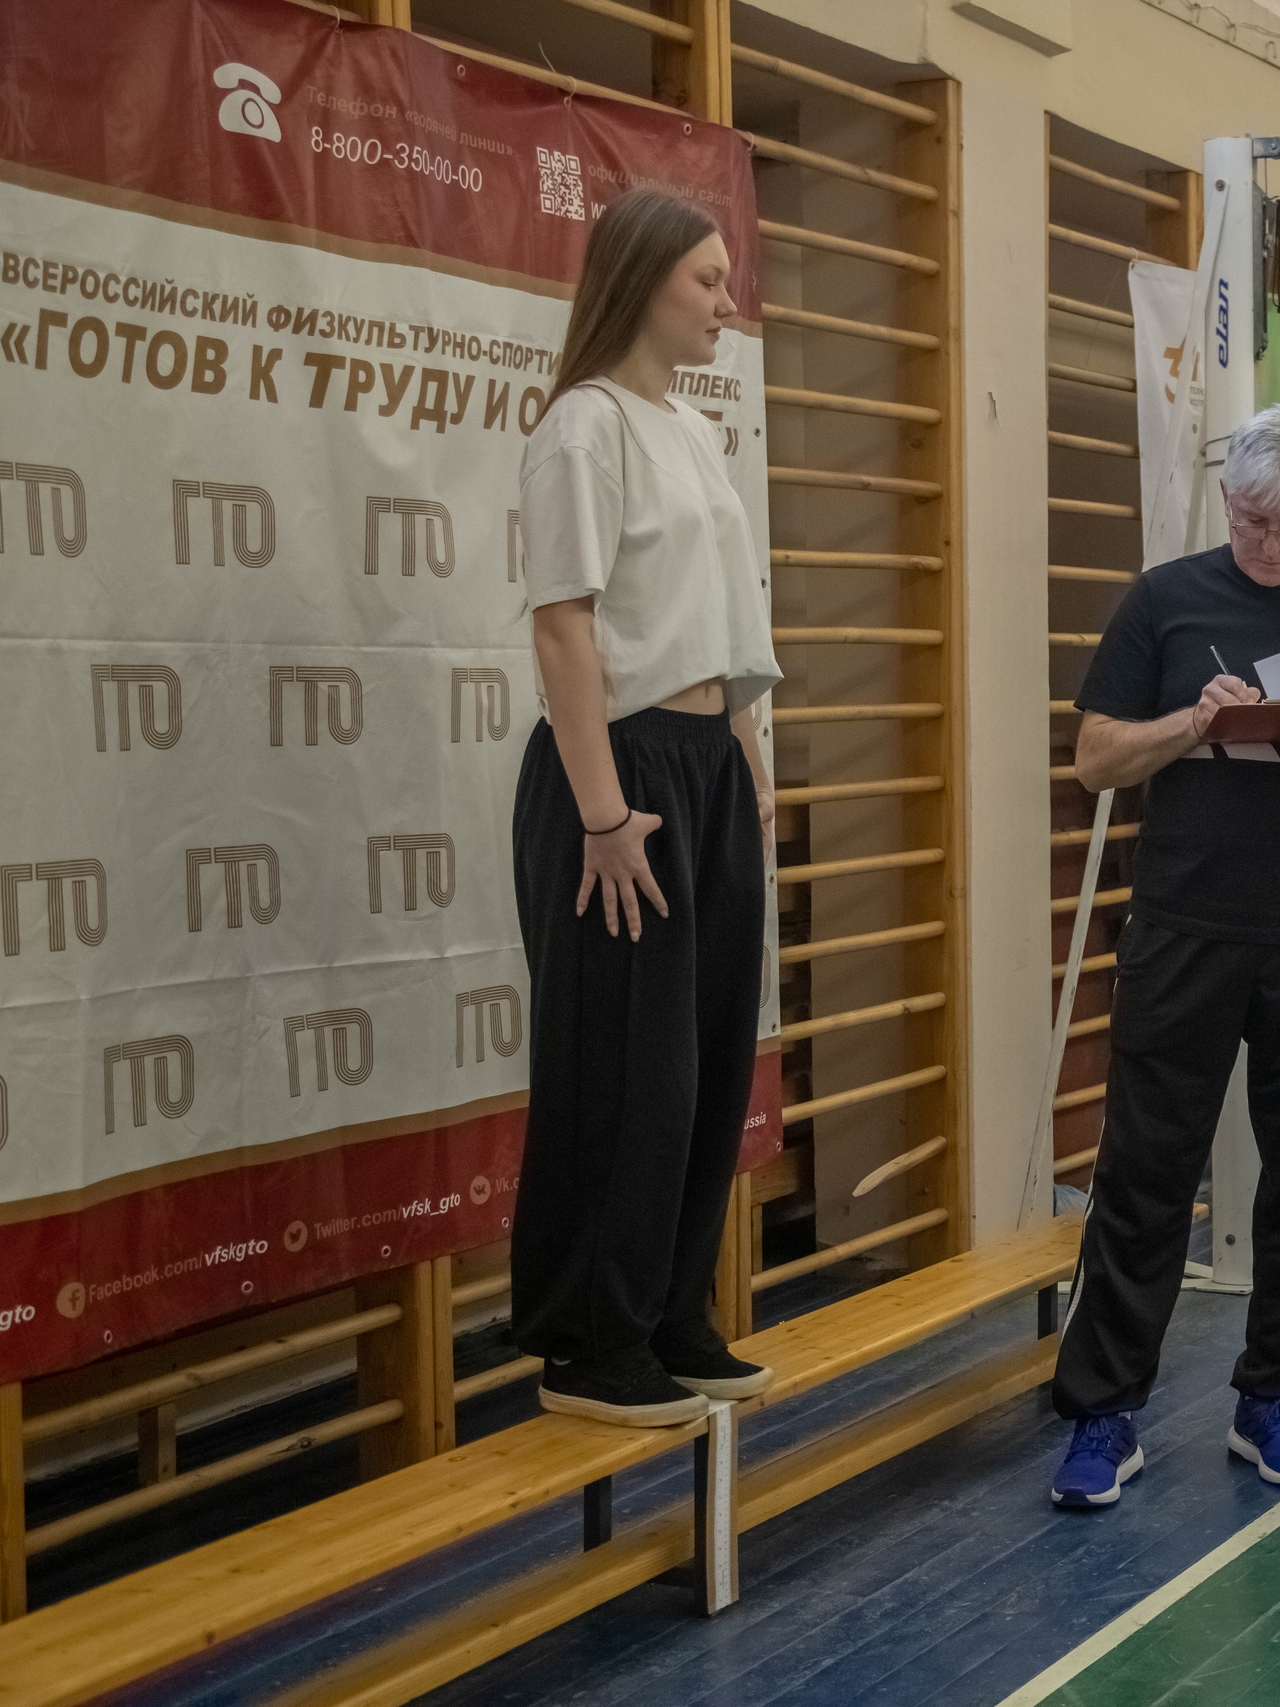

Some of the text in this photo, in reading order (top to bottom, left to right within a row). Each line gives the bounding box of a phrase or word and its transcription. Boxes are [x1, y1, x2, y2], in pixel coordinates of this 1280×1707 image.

[306, 85, 398, 120] Телефон
[311, 126, 483, 193] 8-800-350-00-00
[1, 252, 259, 328] ВСЕРОССИЙСКИЙ
[1215, 278, 1229, 369] elan
[0, 307, 230, 395] «ГОТОВ
[249, 344, 284, 404] К
[303, 351, 476, 434] ТРУДУ
[483, 378, 510, 432] И
[173, 479, 276, 568] ГТО
[364, 495, 456, 578] ГТО
[91, 664, 511, 752] ГТО ГТО ГТО
[0, 833, 456, 956] ГТО ГТО ГТО
[104, 1034, 194, 1135] ГТО
[283, 1007, 374, 1098] ГТО
[456, 984, 523, 1068] ГТО
[314, 1192, 461, 1240] Twitter.com/vfsk_gto
[88, 1239, 269, 1303] Facebook.com/vfskgto
